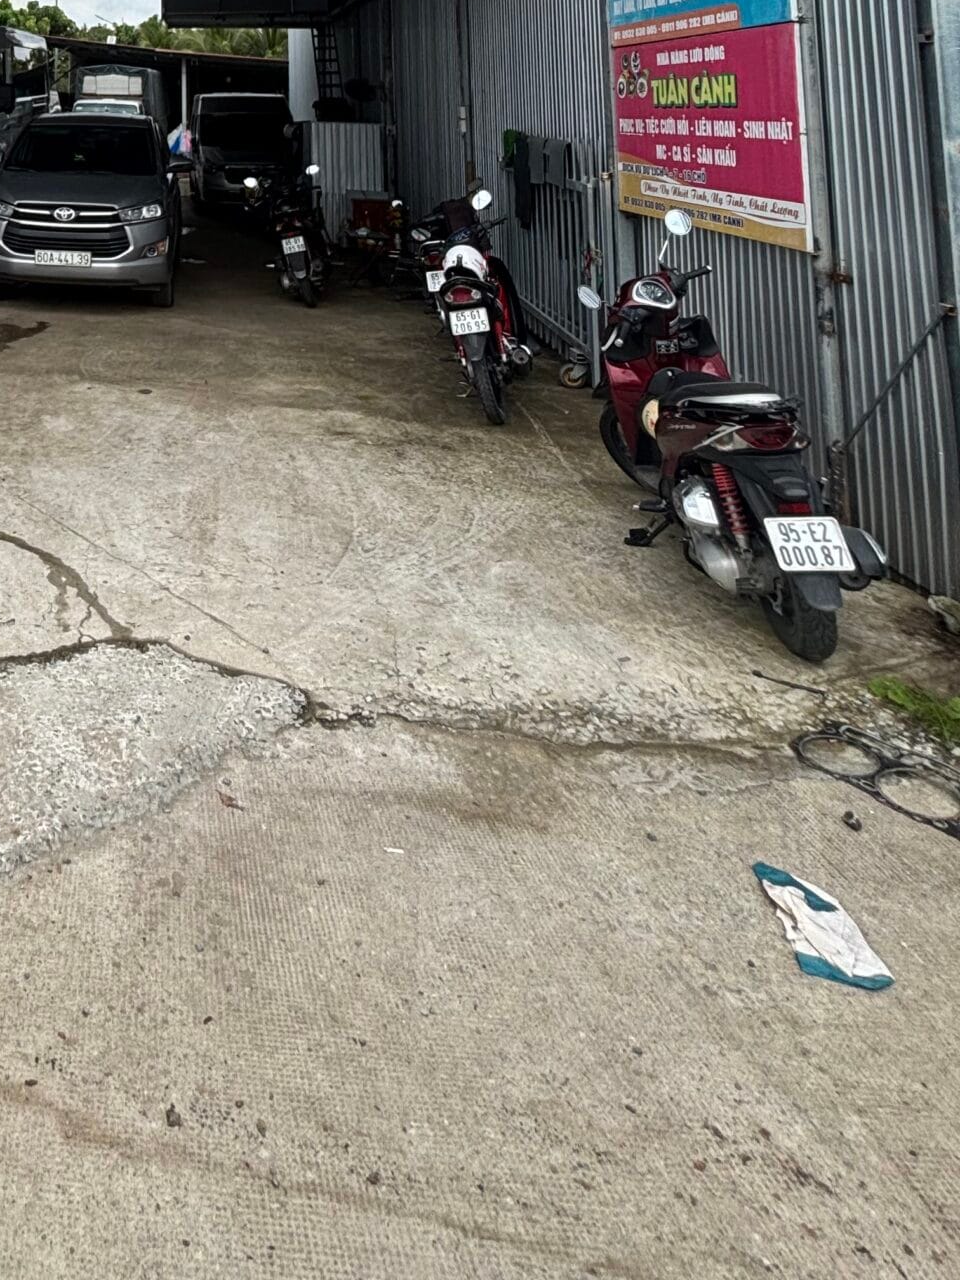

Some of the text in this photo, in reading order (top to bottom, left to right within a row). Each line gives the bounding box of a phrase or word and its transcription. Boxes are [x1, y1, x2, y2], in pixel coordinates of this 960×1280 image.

[691, 70, 737, 108] CẢNH
[743, 121, 765, 140] SINH
[767, 118, 793, 144] NHẬT
[456, 310, 480, 322] 65-G1
[779, 523, 832, 543] 95-E2
[779, 545, 843, 567] 000.87
